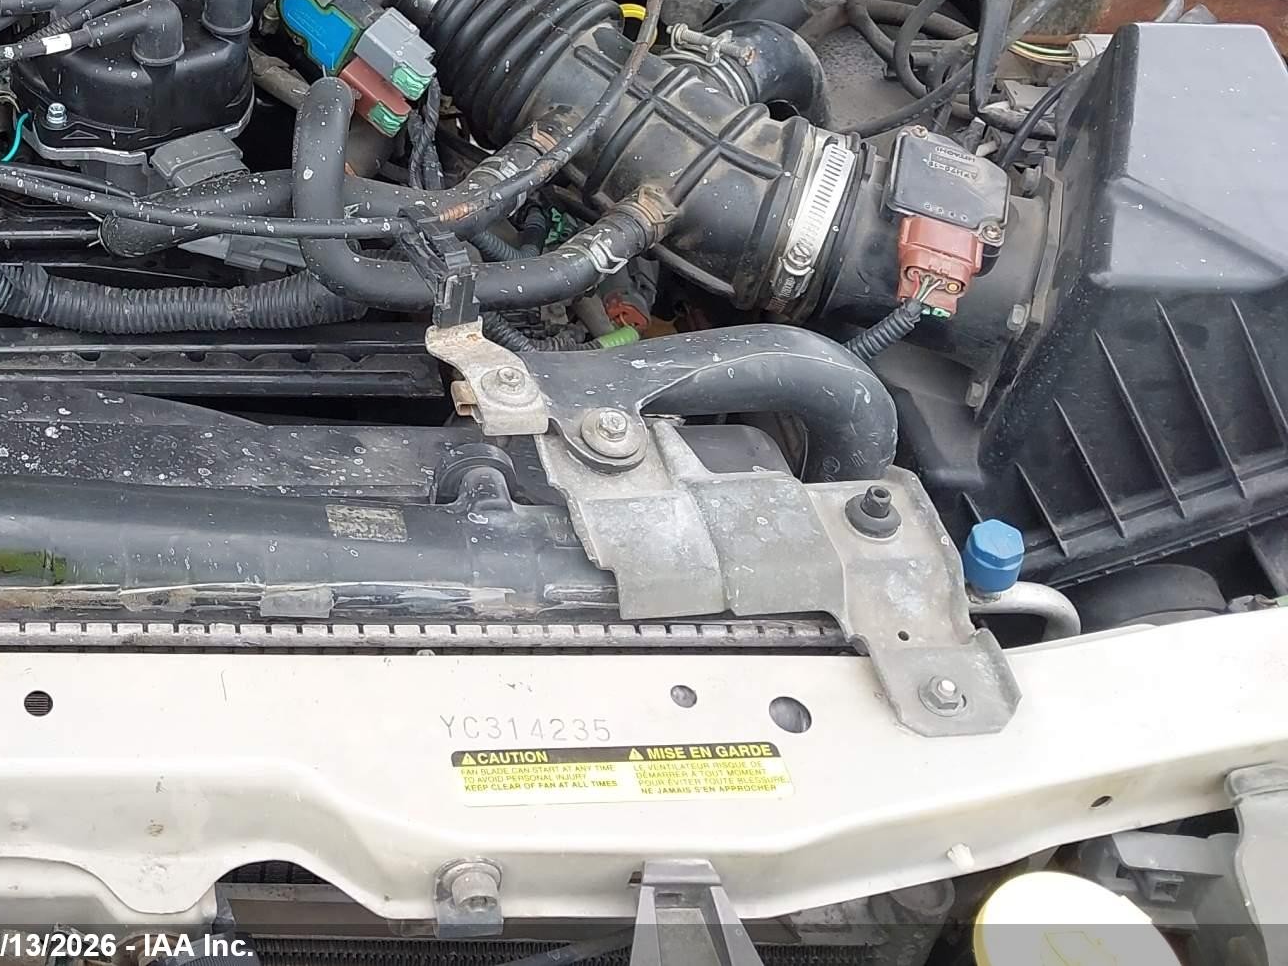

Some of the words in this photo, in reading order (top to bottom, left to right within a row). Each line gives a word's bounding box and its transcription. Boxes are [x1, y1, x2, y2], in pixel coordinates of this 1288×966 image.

[440, 714, 611, 741] YC314235
[646, 747, 686, 760] MISE
[689, 746, 712, 759] EN
[715, 744, 773, 758] GARDE
[477, 751, 548, 764] CAUTION
[648, 762, 710, 771] VENTILATEUR
[713, 761, 745, 769] RISQUE
[481, 767, 510, 775] BLADE
[701, 769, 723, 777] TOUT
[478, 775, 503, 783] AVOID
[506, 774, 552, 782] PERSONAL
[704, 777, 734, 785] TOUTE
[465, 784, 488, 792] KEEP
[719, 784, 776, 792] APPROCHER
